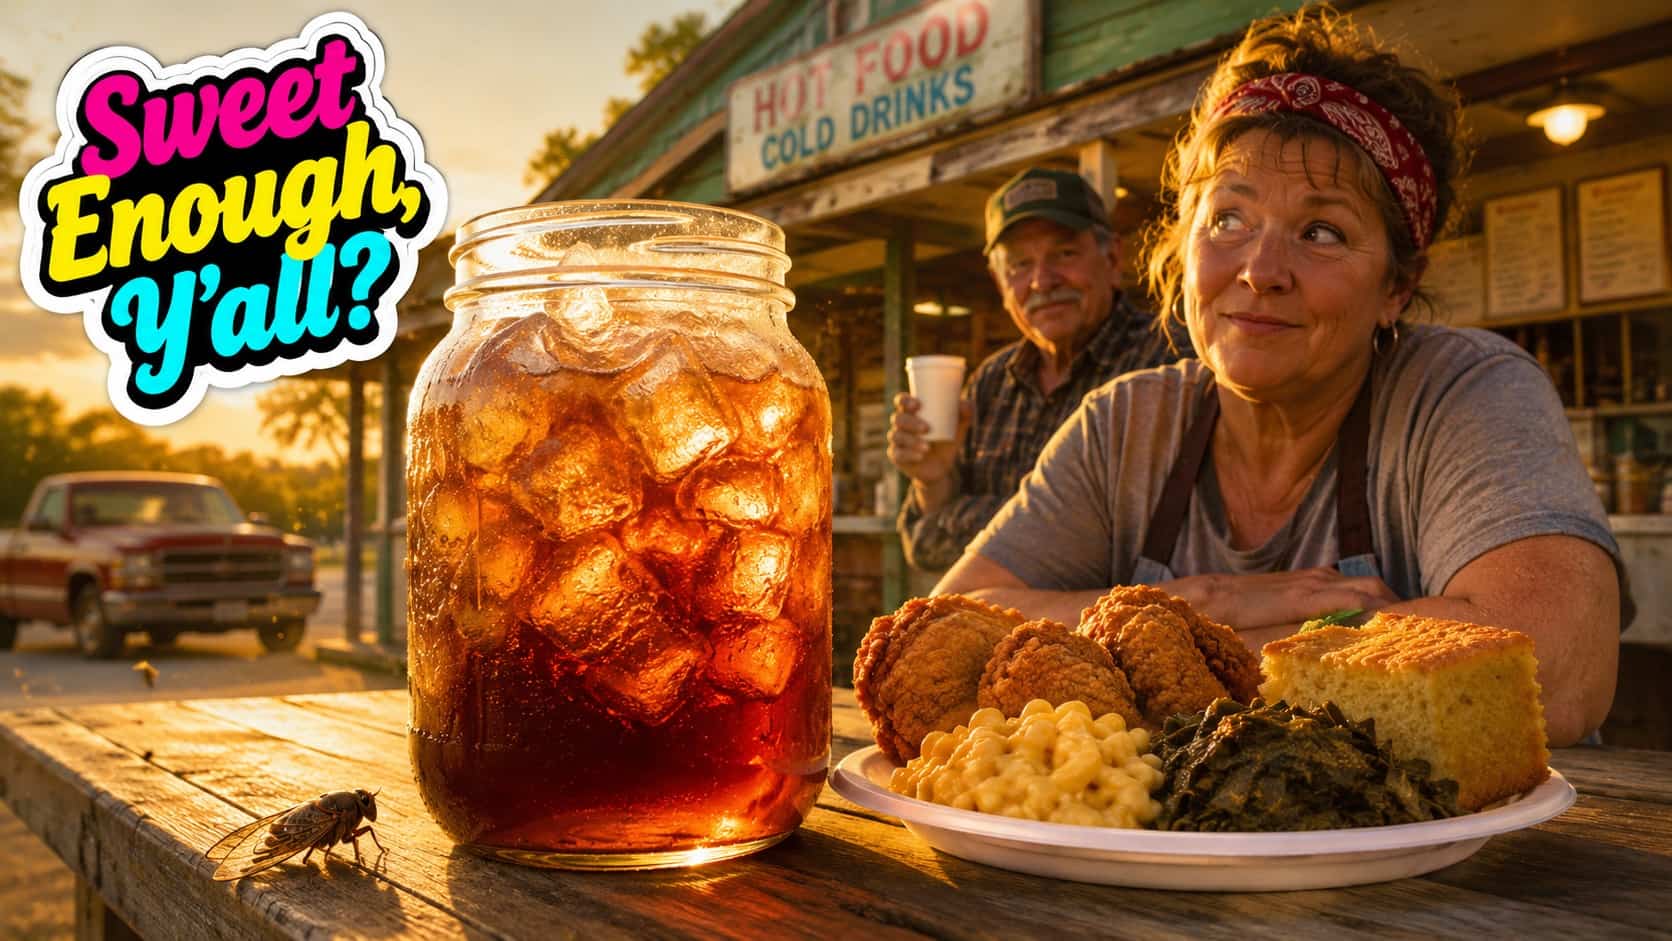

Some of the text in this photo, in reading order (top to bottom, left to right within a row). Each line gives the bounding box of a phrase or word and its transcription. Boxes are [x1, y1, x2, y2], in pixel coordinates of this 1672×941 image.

[753, 2, 989, 133] HOT FOOD
[761, 64, 976, 169] COLD DRINKS
